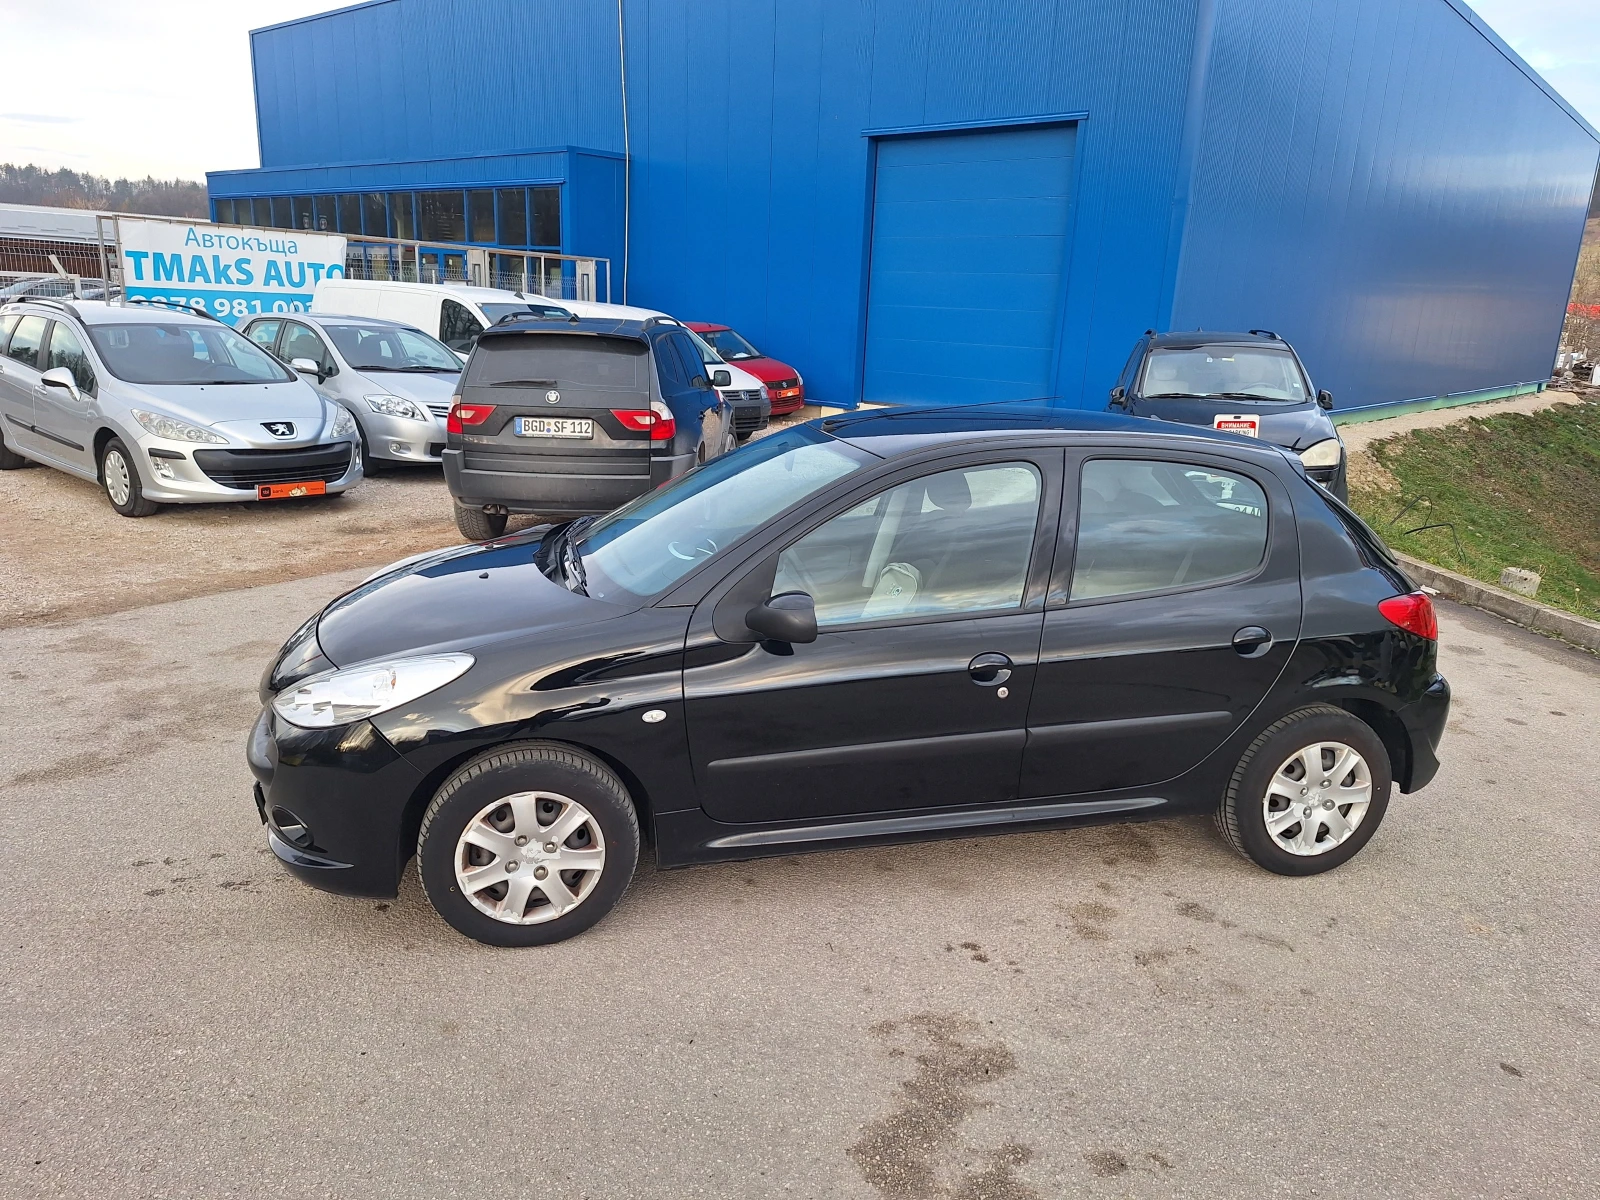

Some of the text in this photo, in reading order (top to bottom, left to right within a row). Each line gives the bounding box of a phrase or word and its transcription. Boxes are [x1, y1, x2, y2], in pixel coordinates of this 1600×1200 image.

[184, 227, 299, 257] Автокъща
[125, 250, 254, 286] TMAkS
[213, 298, 262, 317] 981
[523, 419, 591, 434] BGD SF 112
